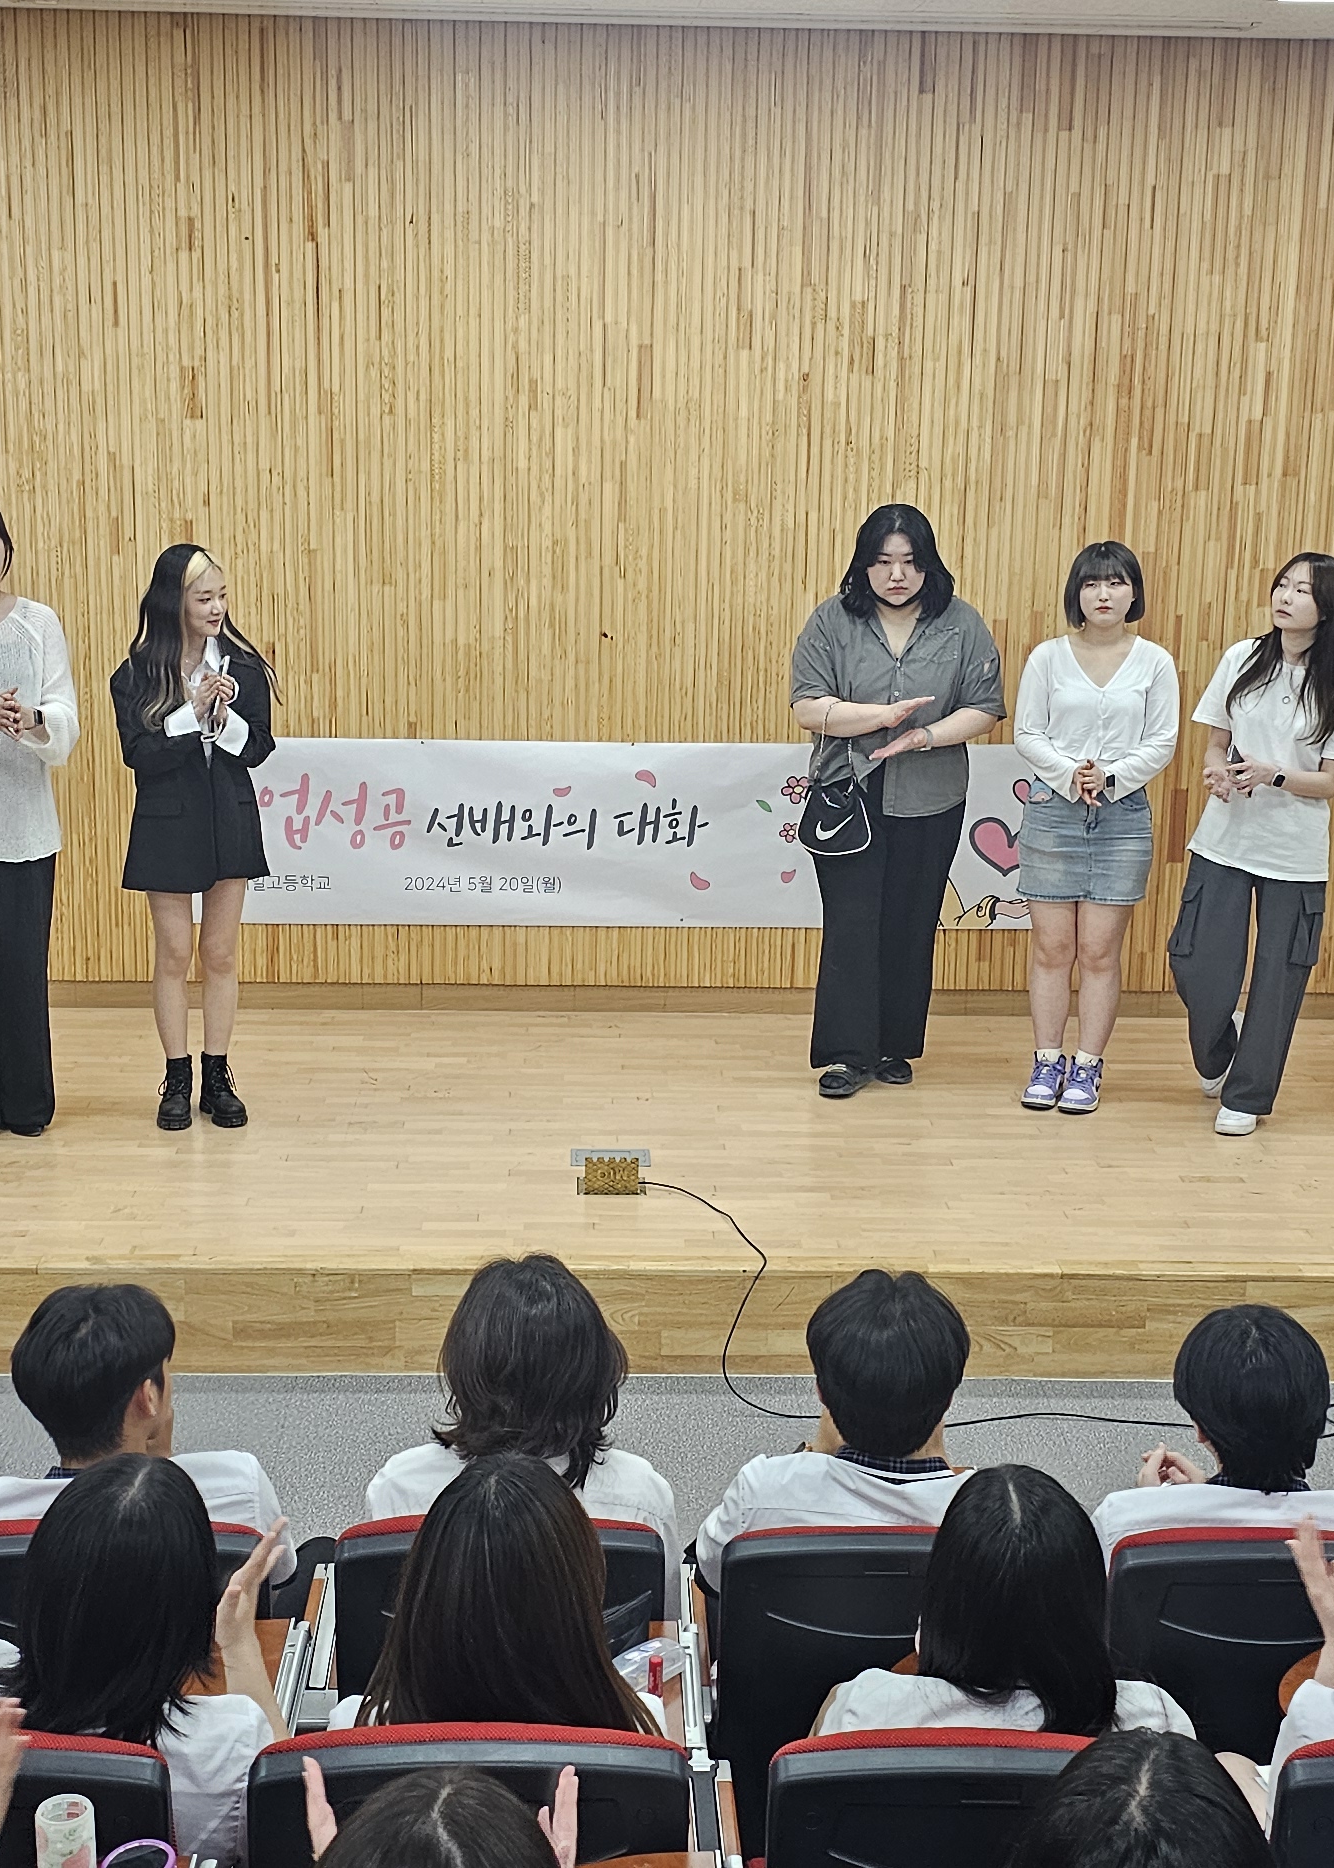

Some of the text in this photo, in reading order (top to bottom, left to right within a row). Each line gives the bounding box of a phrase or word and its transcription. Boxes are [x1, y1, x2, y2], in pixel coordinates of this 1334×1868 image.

[425, 800, 598, 850] 선배와의
[612, 797, 709, 848] 대화
[246, 874, 332, 892] 일고등학교
[403, 875, 562, 894] 2024년 5월 20일(월)
